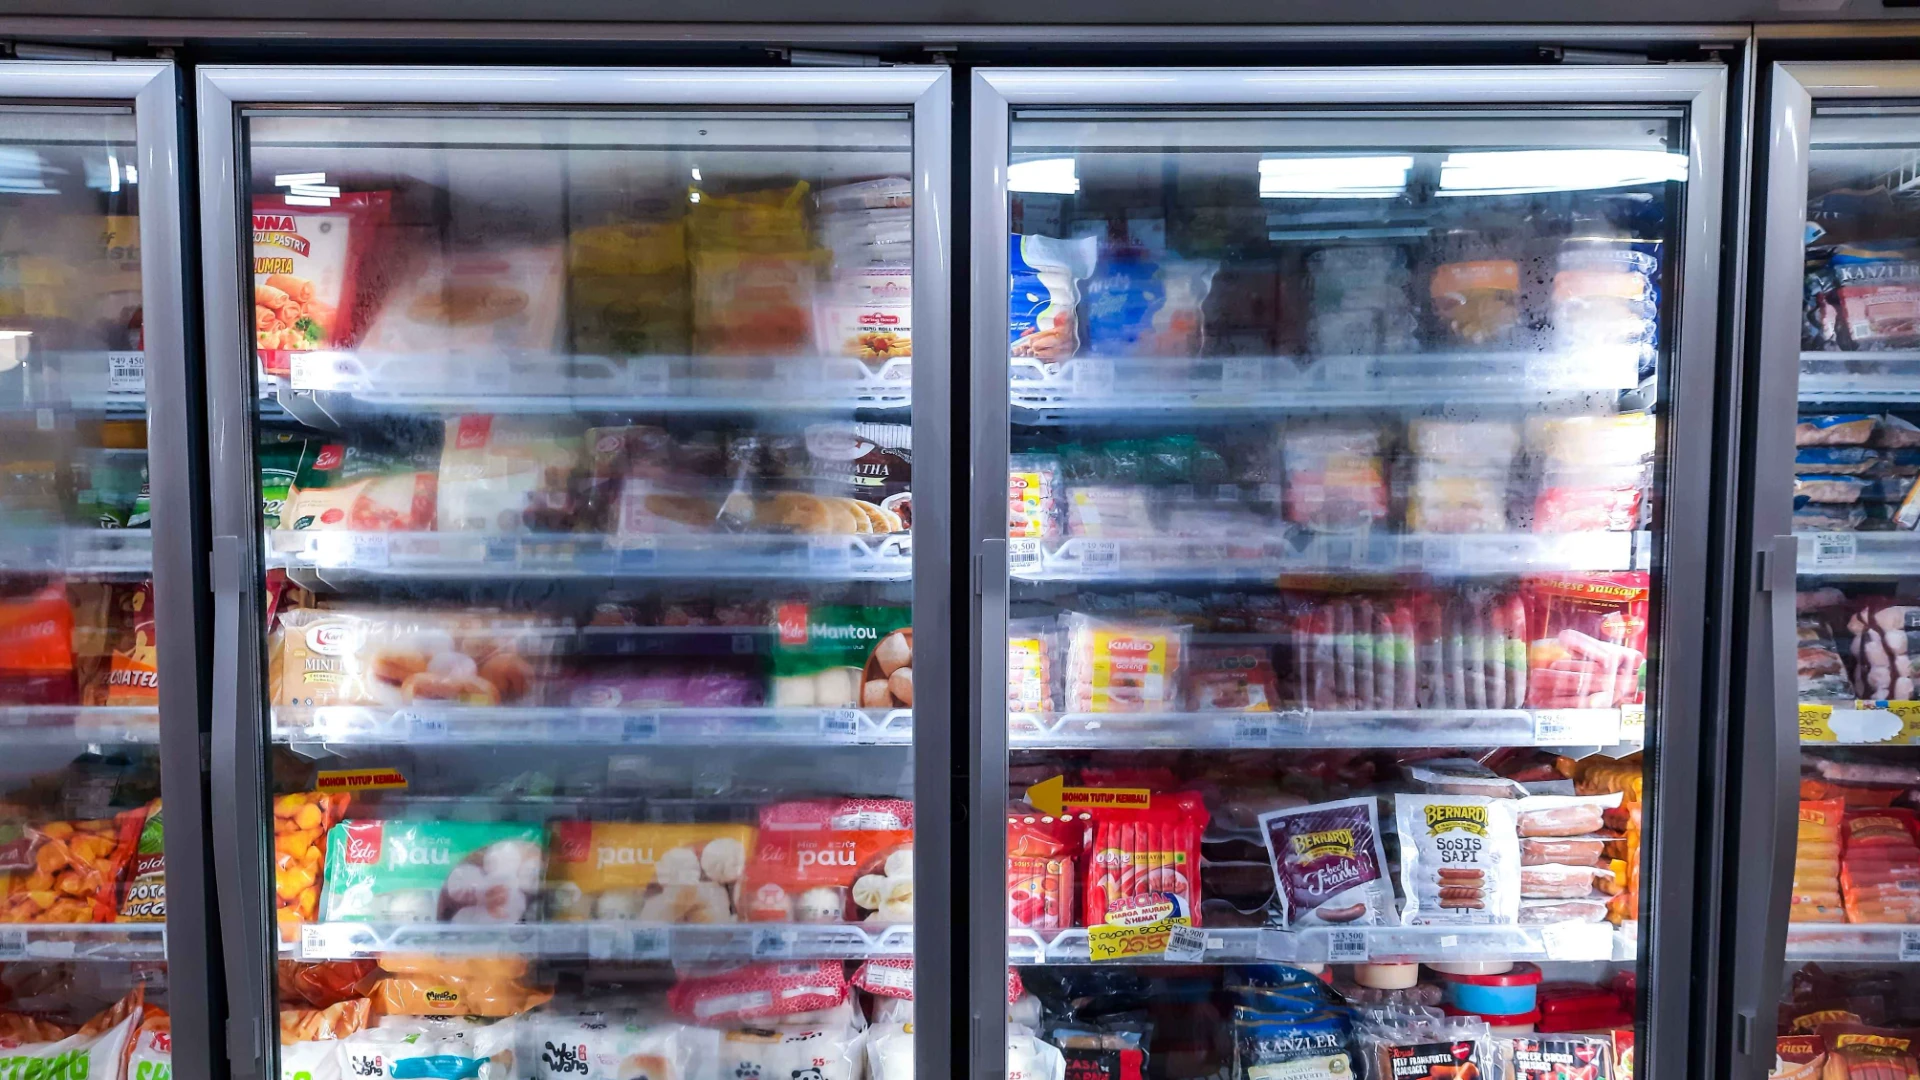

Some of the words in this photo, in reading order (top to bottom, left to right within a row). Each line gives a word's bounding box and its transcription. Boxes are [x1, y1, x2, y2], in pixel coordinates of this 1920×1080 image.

[253, 232, 271, 242] OLL
[274, 233, 306, 252] PASTRY
[811, 624, 878, 640] Mantou
[1108, 641, 1154, 651] KIMBO
[305, 659, 334, 671] MINI
[318, 776, 346, 787] MOHON
[347, 775, 372, 786] TUTUP
[1062, 792, 1088, 802] MOHON
[1090, 793, 1115, 803] TUTUP
[1116, 794, 1148, 803] KEMBALI
[1424, 805, 1489, 826] BERNARDI
[1291, 829, 1355, 856] BERNARDI
[388, 838, 450, 871] pau
[597, 847, 653, 870] pau
[798, 850, 856, 872] pau
[1441, 851, 1478, 862] SAPI
[1326, 859, 1343, 873] beef
[1303, 861, 1358, 896] Franks
[1109, 892, 1171, 912] SPECIAL
[1111, 910, 1138, 920] HARGA
[1142, 904, 1171, 914] MURAH
[545, 1041, 577, 1059] Wei
[1260, 1034, 1339, 1053] KANZLER
[1782, 1044, 1813, 1053] FIESTA
[542, 1053, 589, 1075] Wang
[813, 1058, 825, 1067] 25
[1010, 1072, 1022, 1080] 25
